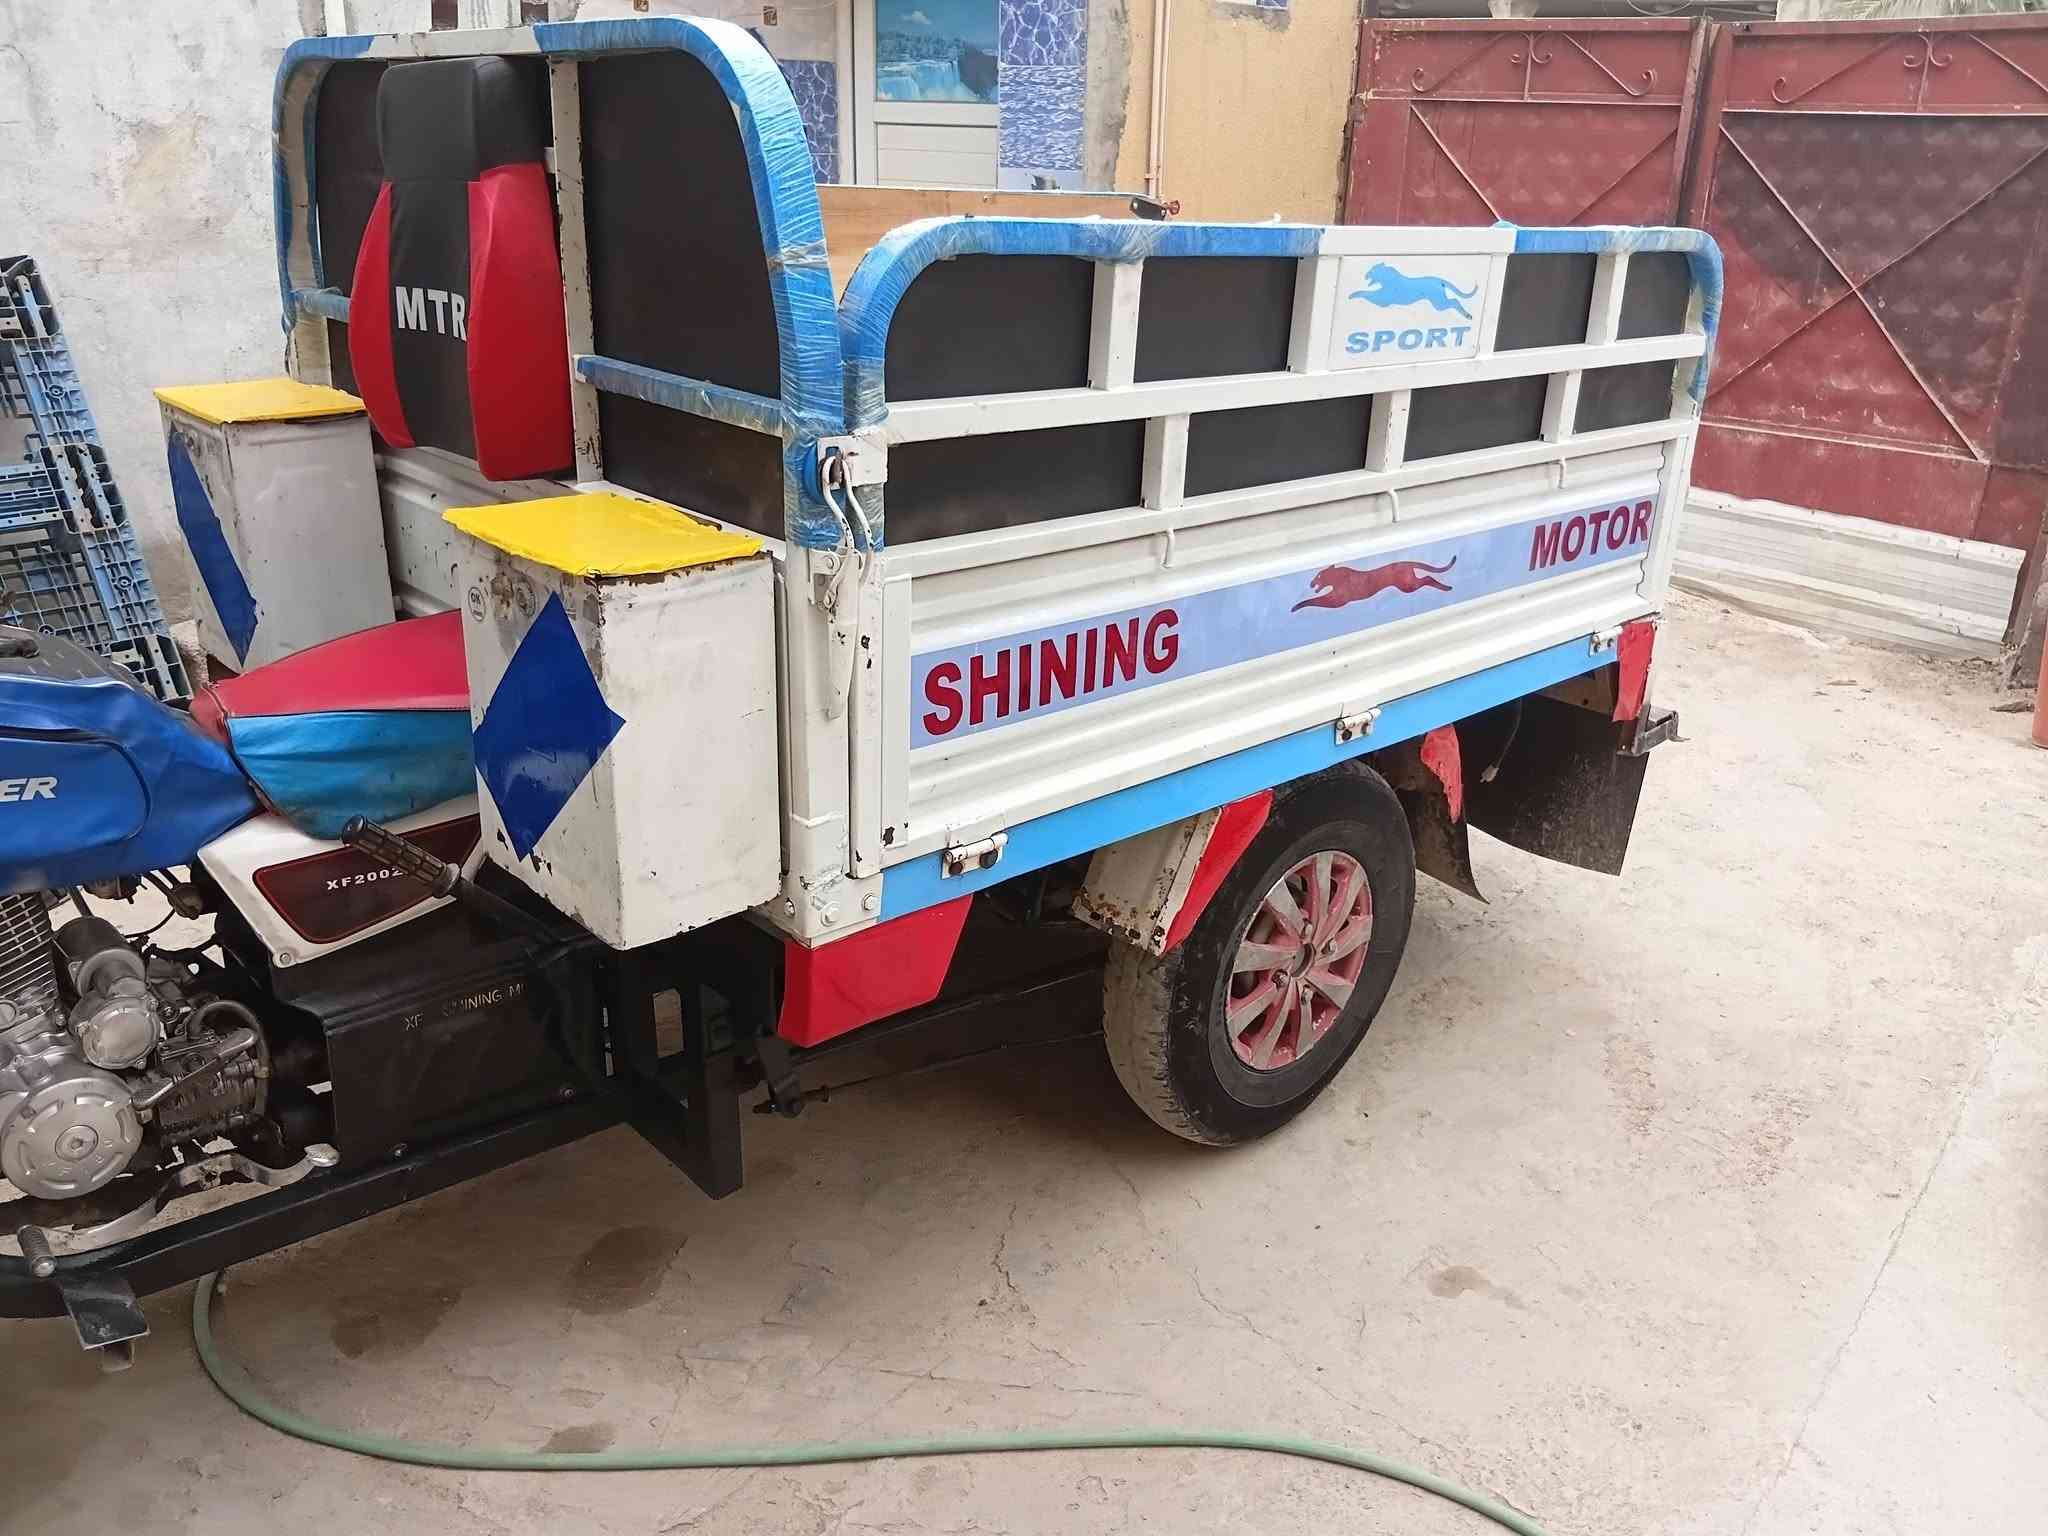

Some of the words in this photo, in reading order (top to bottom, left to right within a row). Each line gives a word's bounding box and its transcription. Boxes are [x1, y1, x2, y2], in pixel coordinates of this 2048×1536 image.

[395, 286, 467, 342] MTR
[1345, 326, 1471, 354] SPORT
[922, 608, 1179, 736] SHINING
[1528, 500, 1653, 572] MOTOR
[442, 989, 503, 1017] INING
